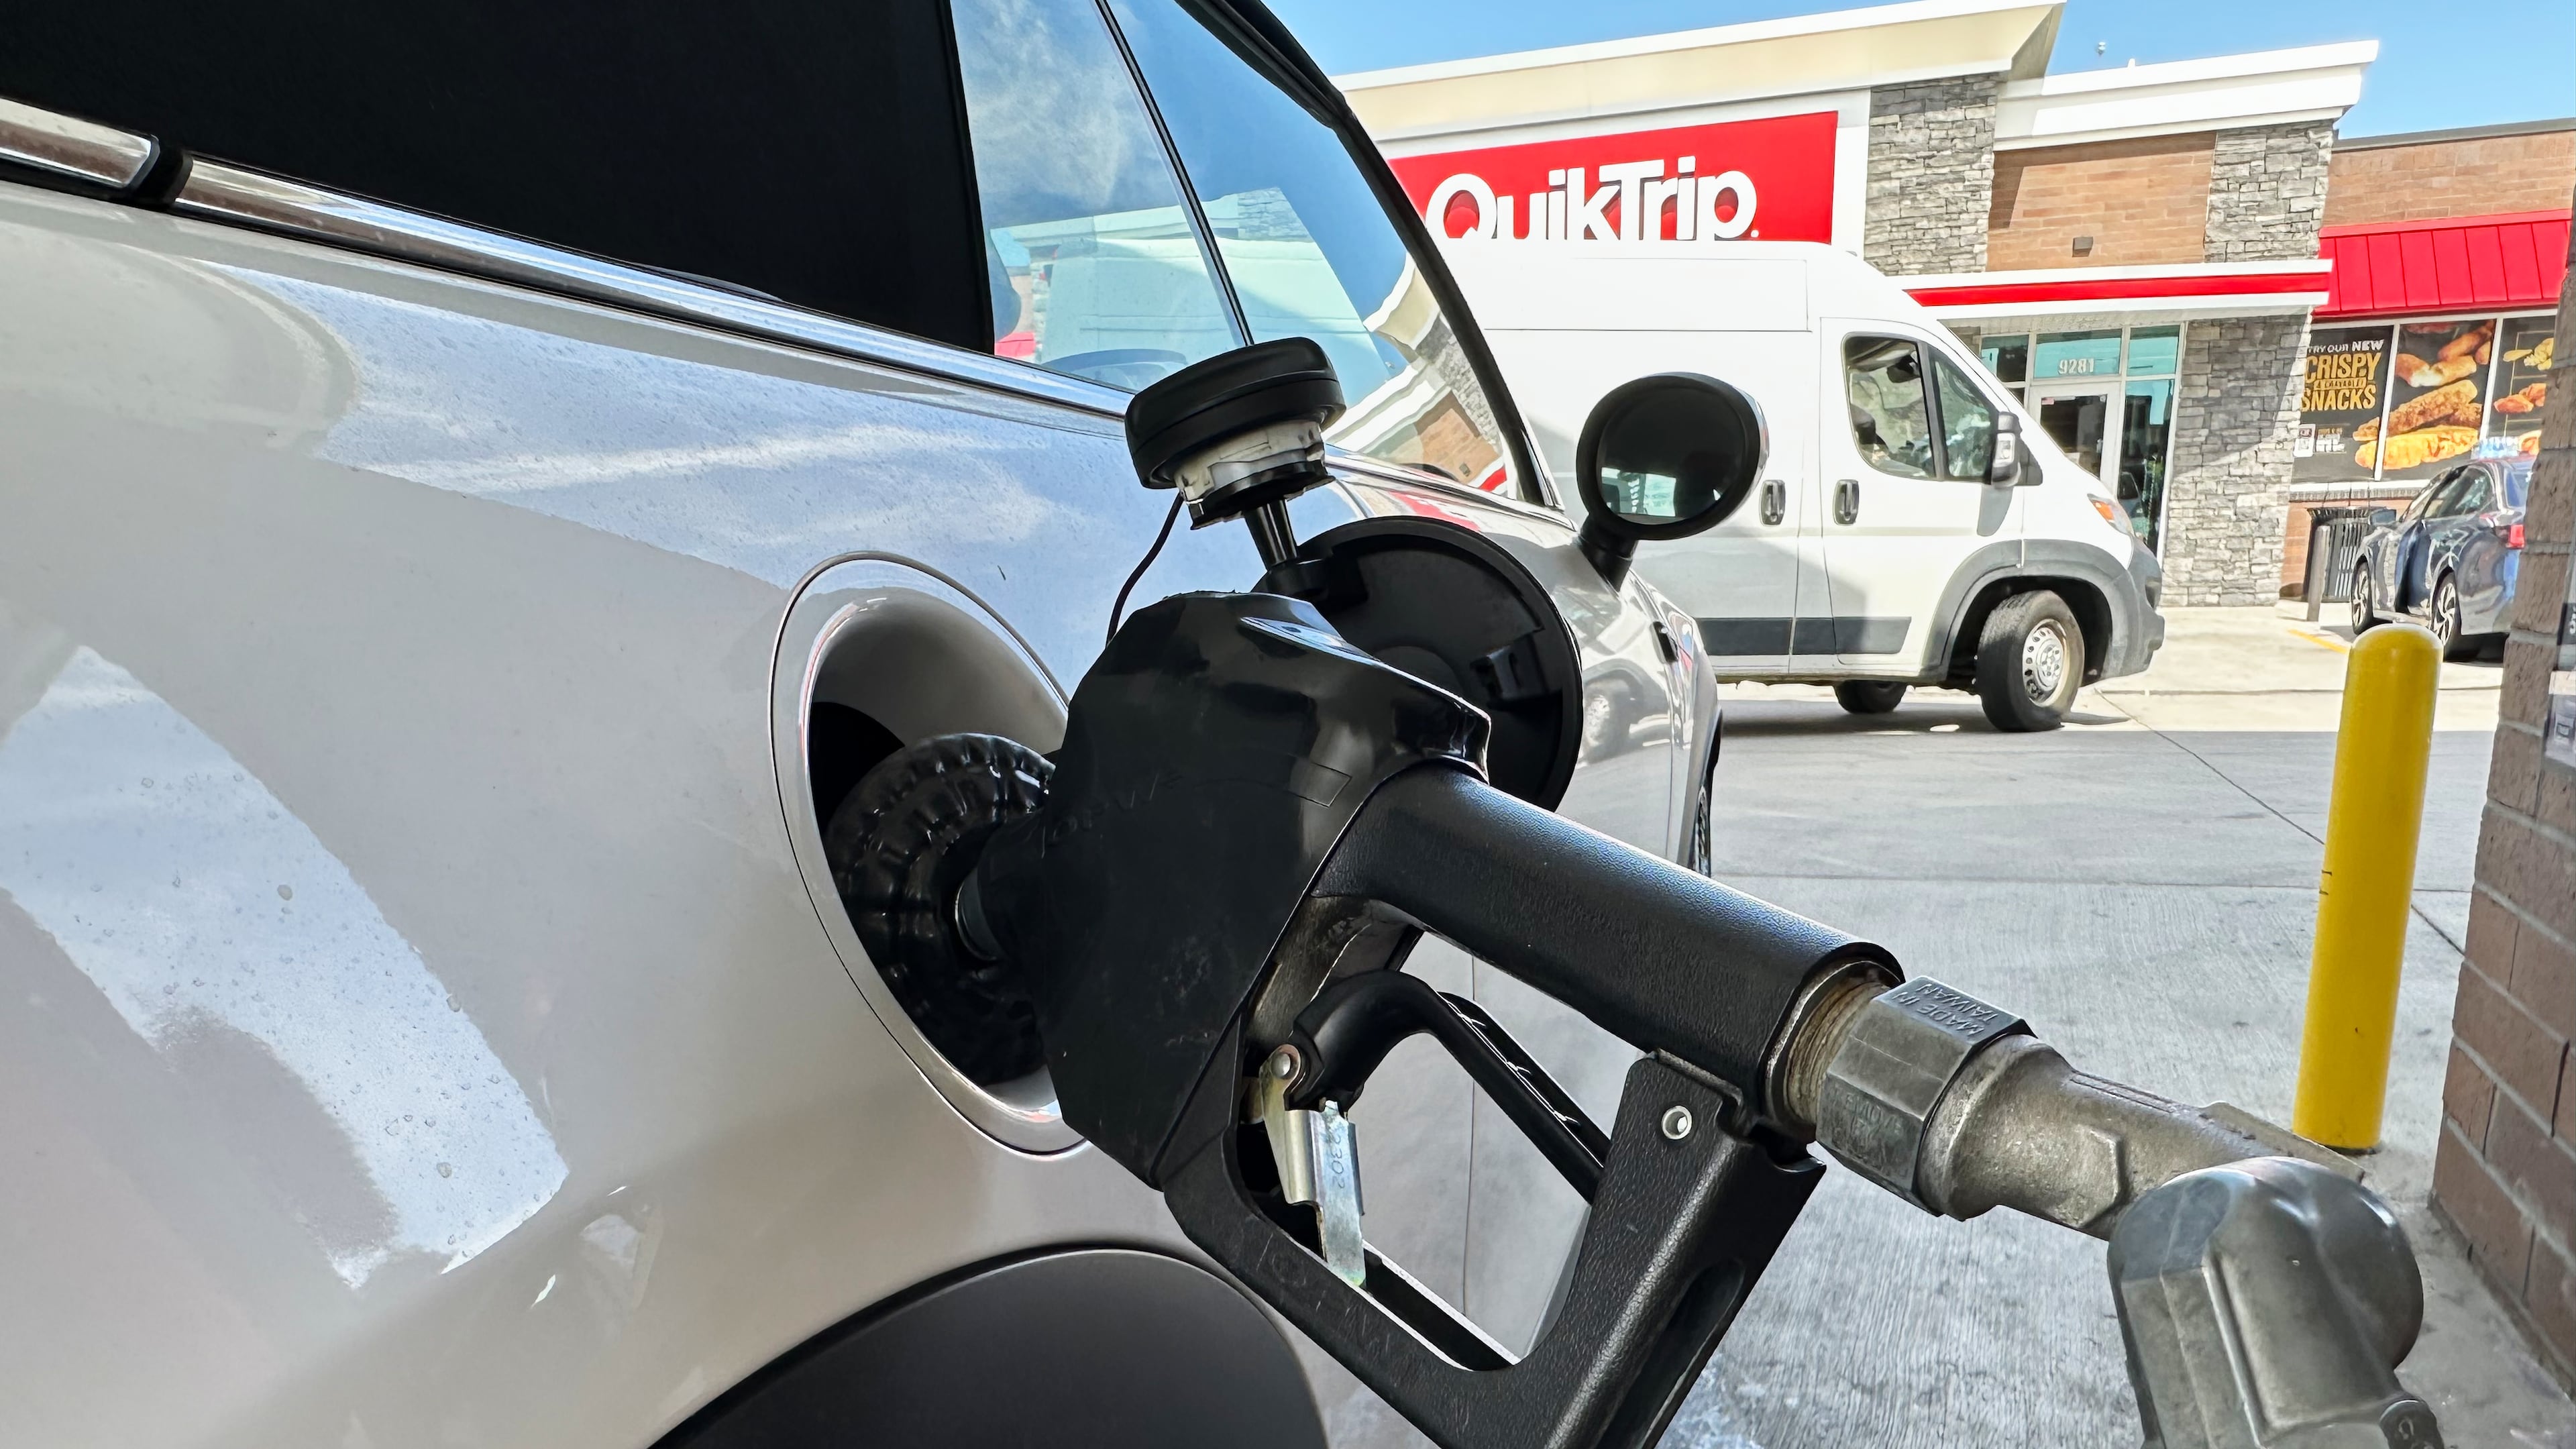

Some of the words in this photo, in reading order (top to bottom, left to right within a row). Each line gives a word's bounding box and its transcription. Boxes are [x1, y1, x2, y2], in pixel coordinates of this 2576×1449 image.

[2326, 343, 2349, 353] OUR
[2351, 339, 2384, 352] NEW
[2058, 358, 2094, 374] 9281
[2305, 352, 2381, 384] CRISPY
[2300, 384, 2376, 412] SNACKS
[1891, 991, 1921, 1006] IN
[1915, 983, 1999, 1022] TAIWAN
[1917, 1004, 1985, 1036] MADE
